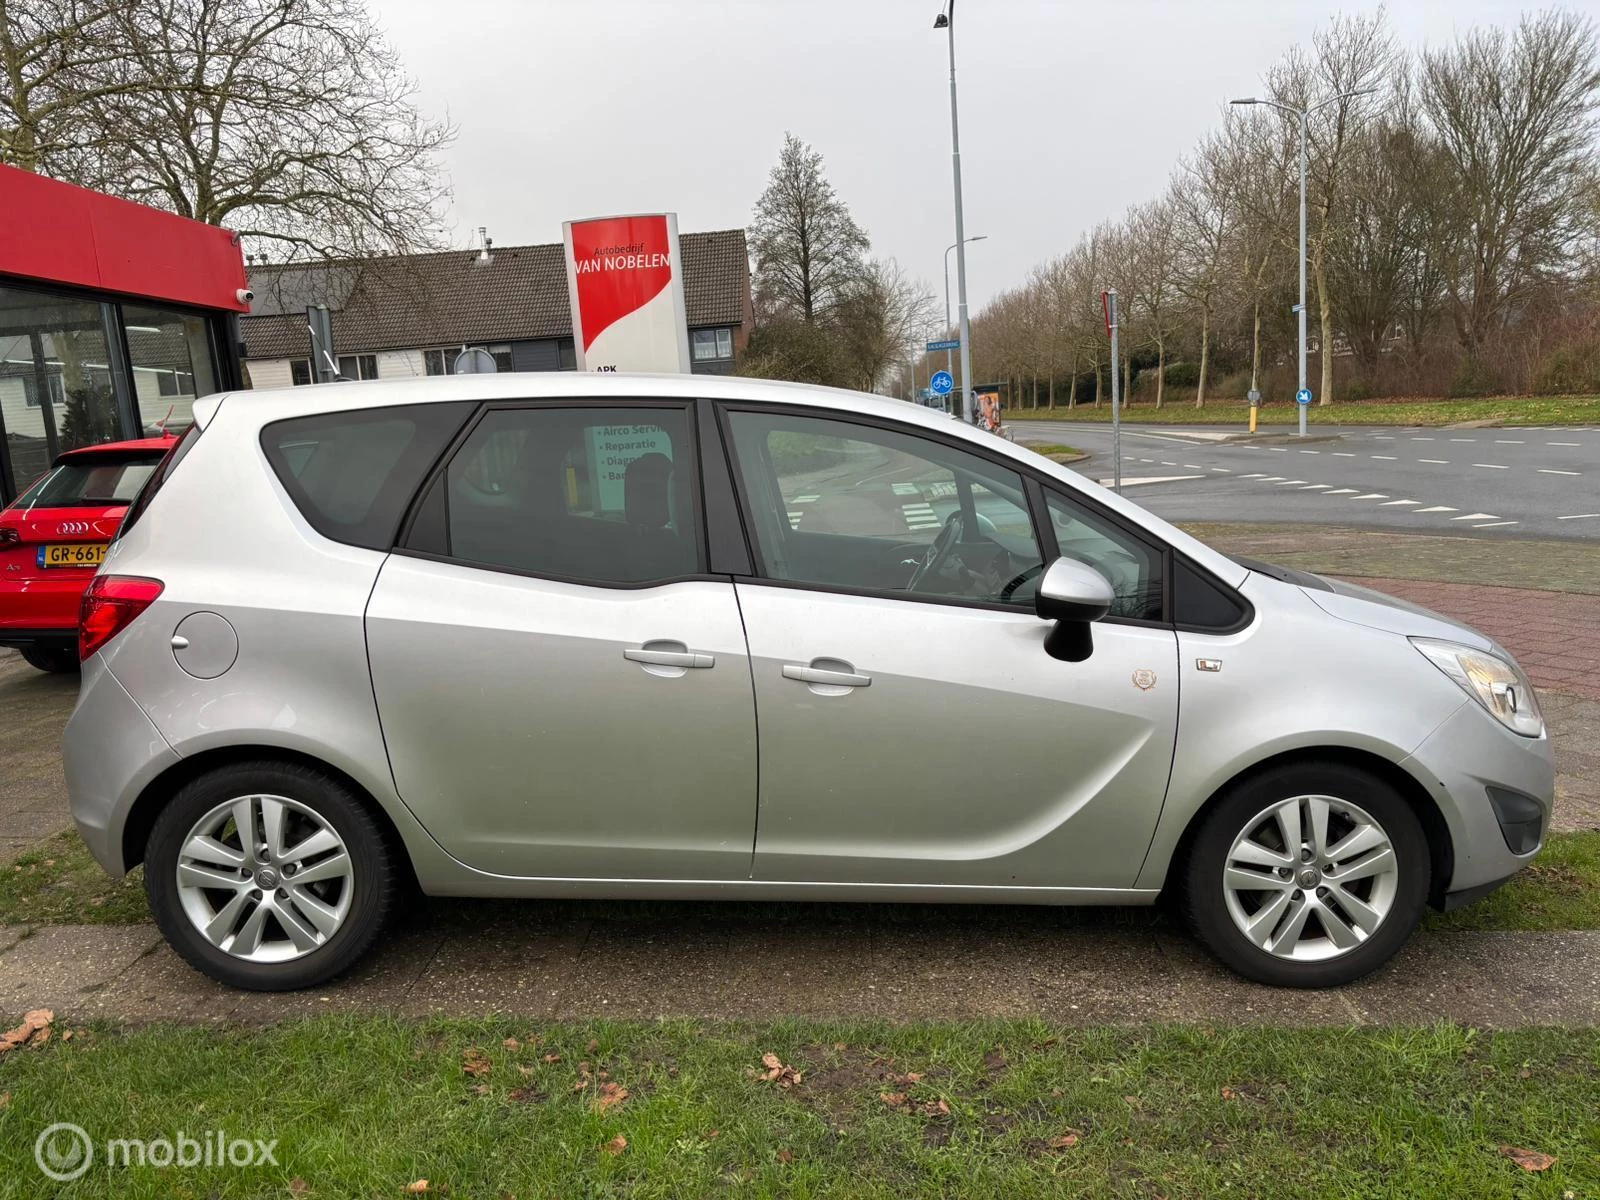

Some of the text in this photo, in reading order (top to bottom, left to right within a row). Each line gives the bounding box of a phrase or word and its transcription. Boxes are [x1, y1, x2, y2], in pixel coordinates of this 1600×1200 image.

[594, 243, 645, 256] Autobedrijf
[575, 253, 670, 274] VAN NOBELEN
[603, 427, 630, 436] Airco
[605, 440, 656, 451] Reparatie
